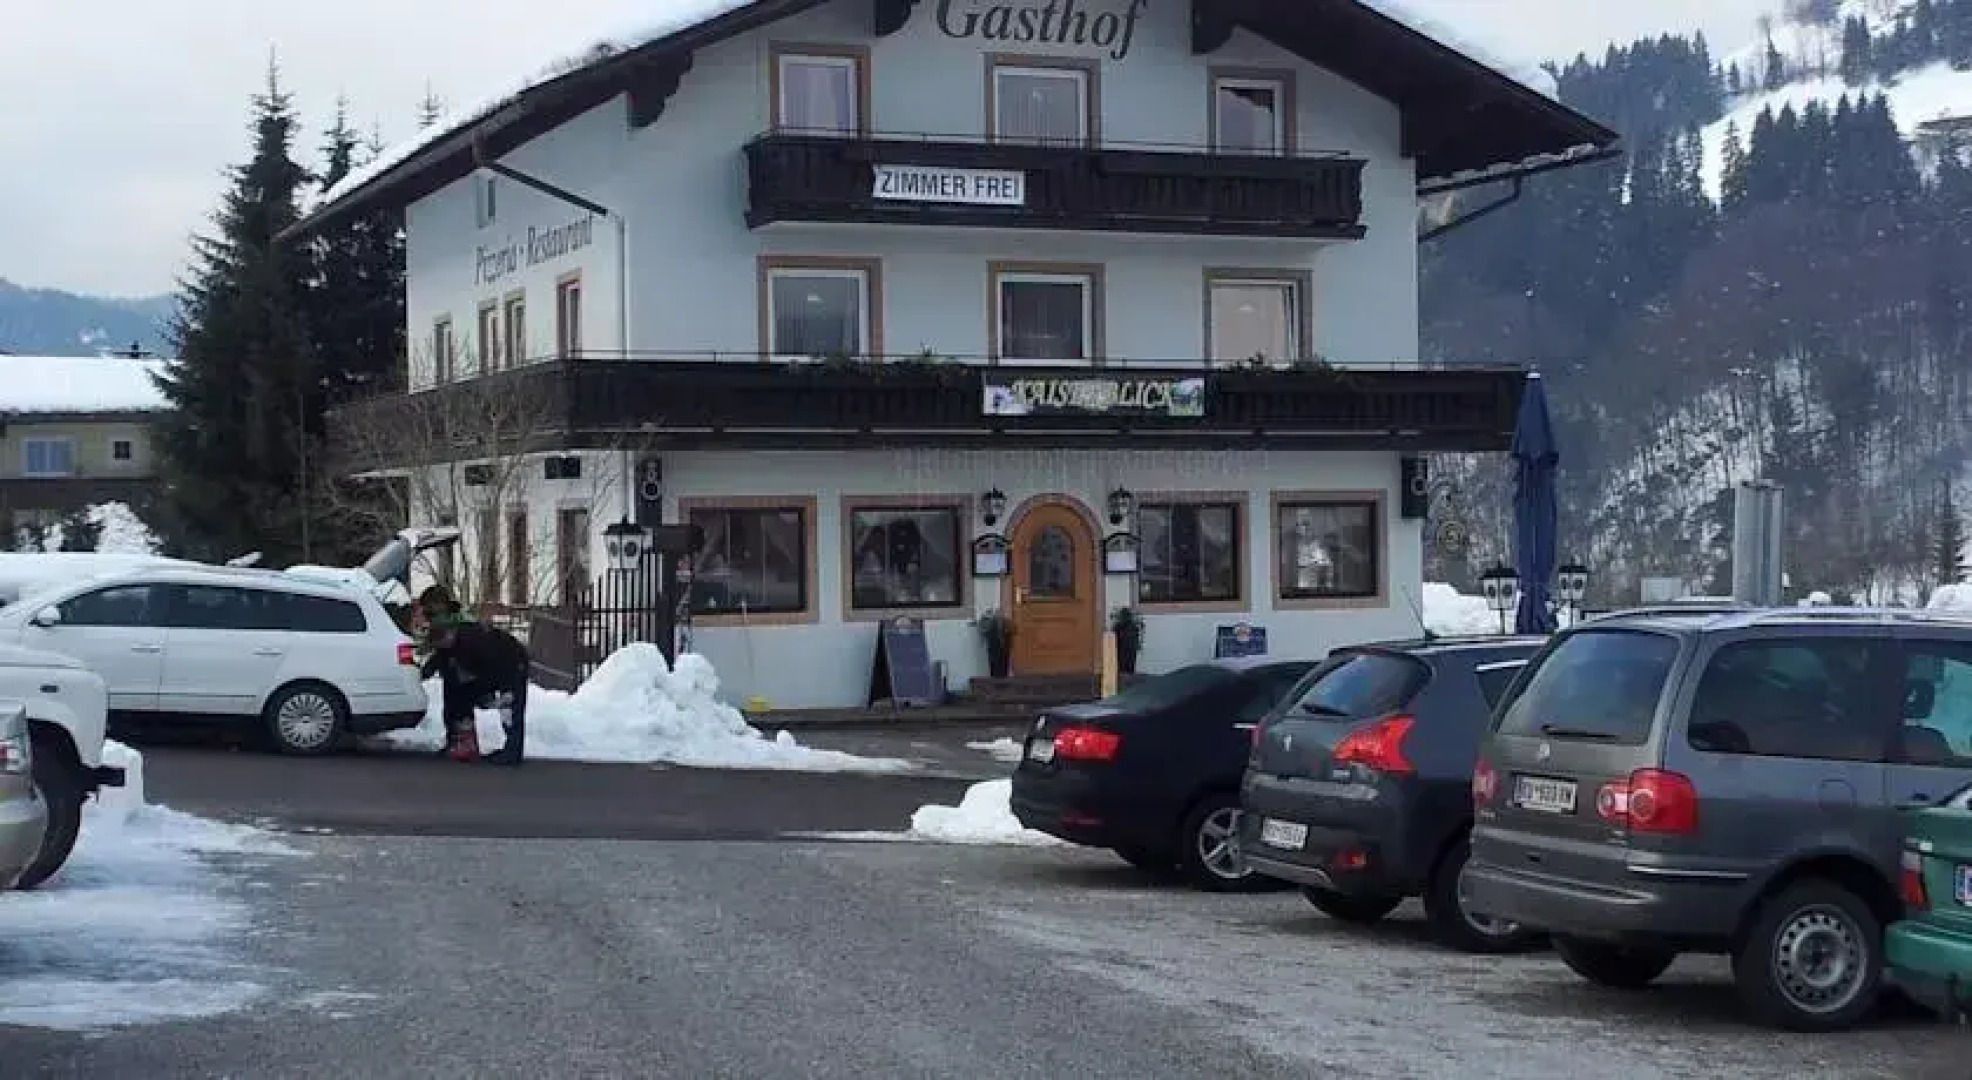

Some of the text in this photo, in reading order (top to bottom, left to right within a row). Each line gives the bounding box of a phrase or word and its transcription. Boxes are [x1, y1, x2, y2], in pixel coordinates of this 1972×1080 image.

[936, 0, 1149, 60] Gasthof
[880, 170, 1021, 199] ZIMMER FREI
[526, 211, 594, 268] Restaurant
